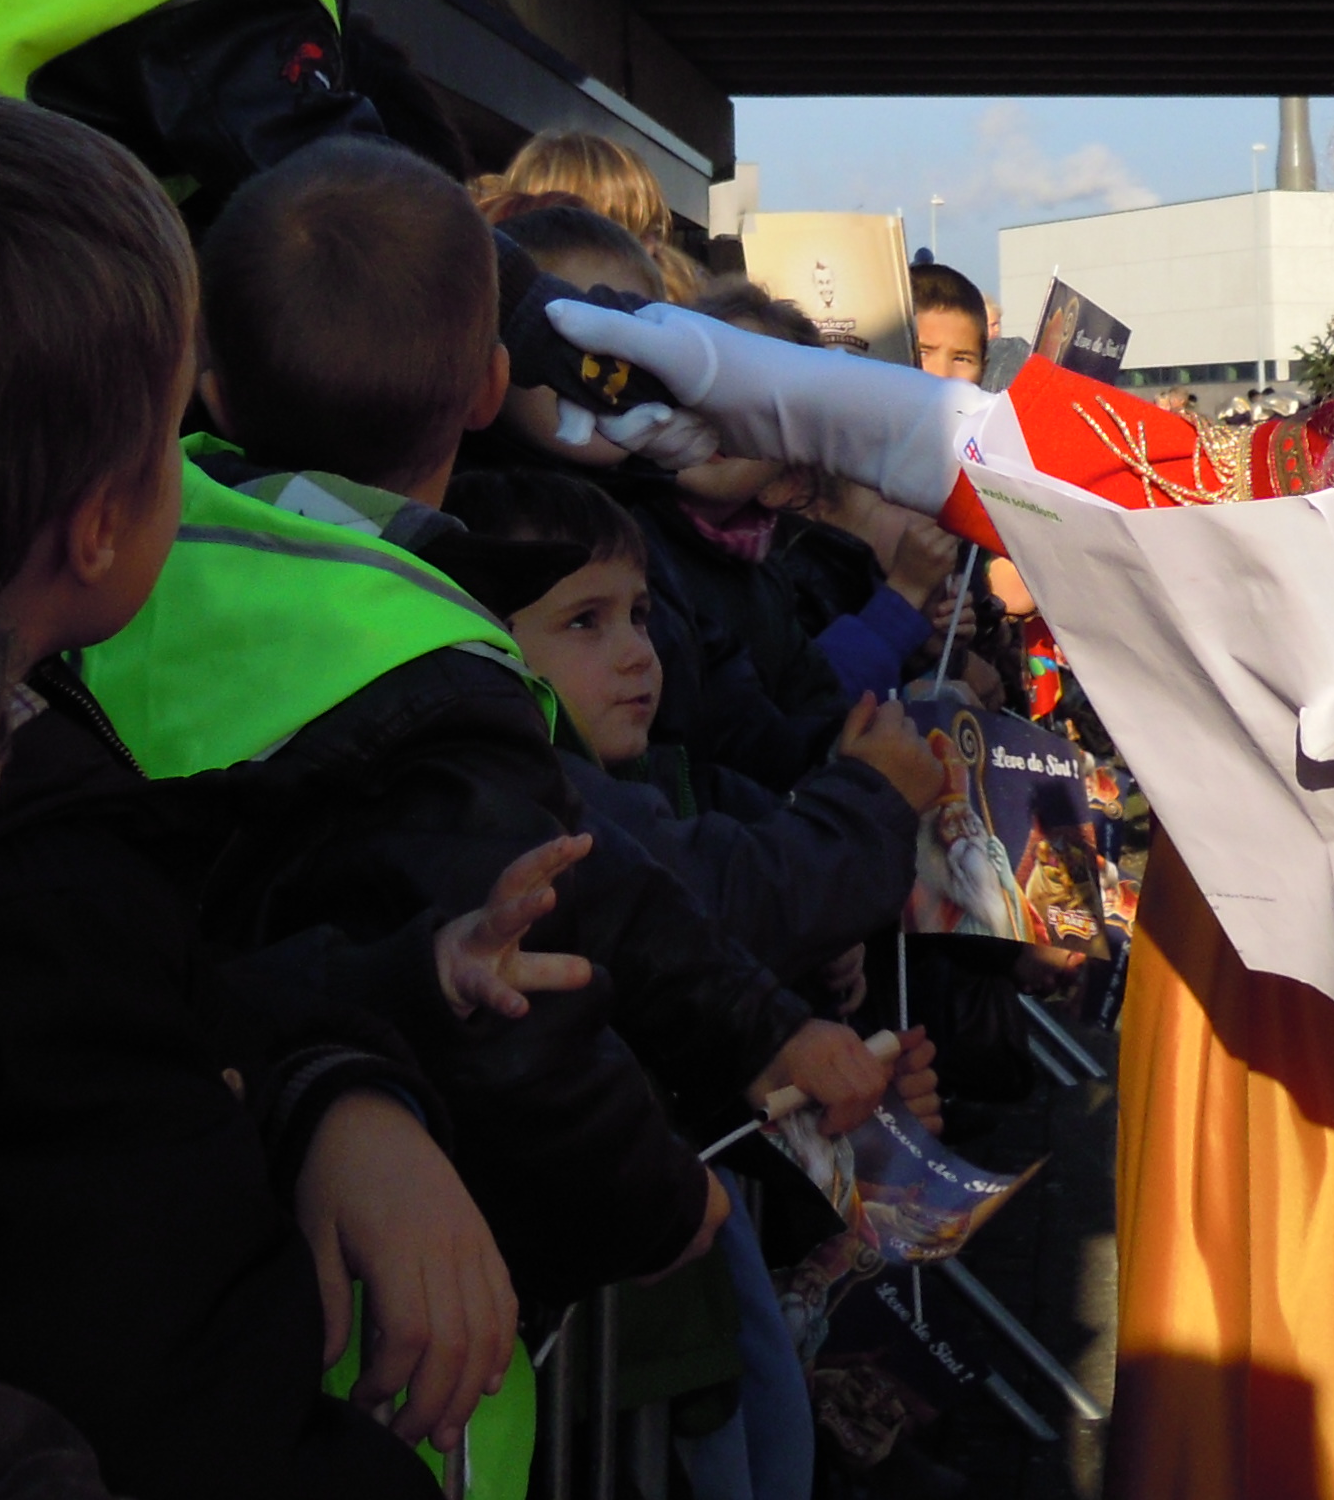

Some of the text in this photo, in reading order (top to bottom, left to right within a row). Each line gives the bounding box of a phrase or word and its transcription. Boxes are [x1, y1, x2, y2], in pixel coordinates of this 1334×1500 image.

[991, 745, 1026, 771] Leve
[1027, 752, 1045, 774] de
[1046, 753, 1072, 778] Sint
[873, 1105, 923, 1159] Leve
[927, 1160, 958, 1183] de
[875, 1282, 911, 1322] Leve
[929, 1341, 965, 1375] Sint
